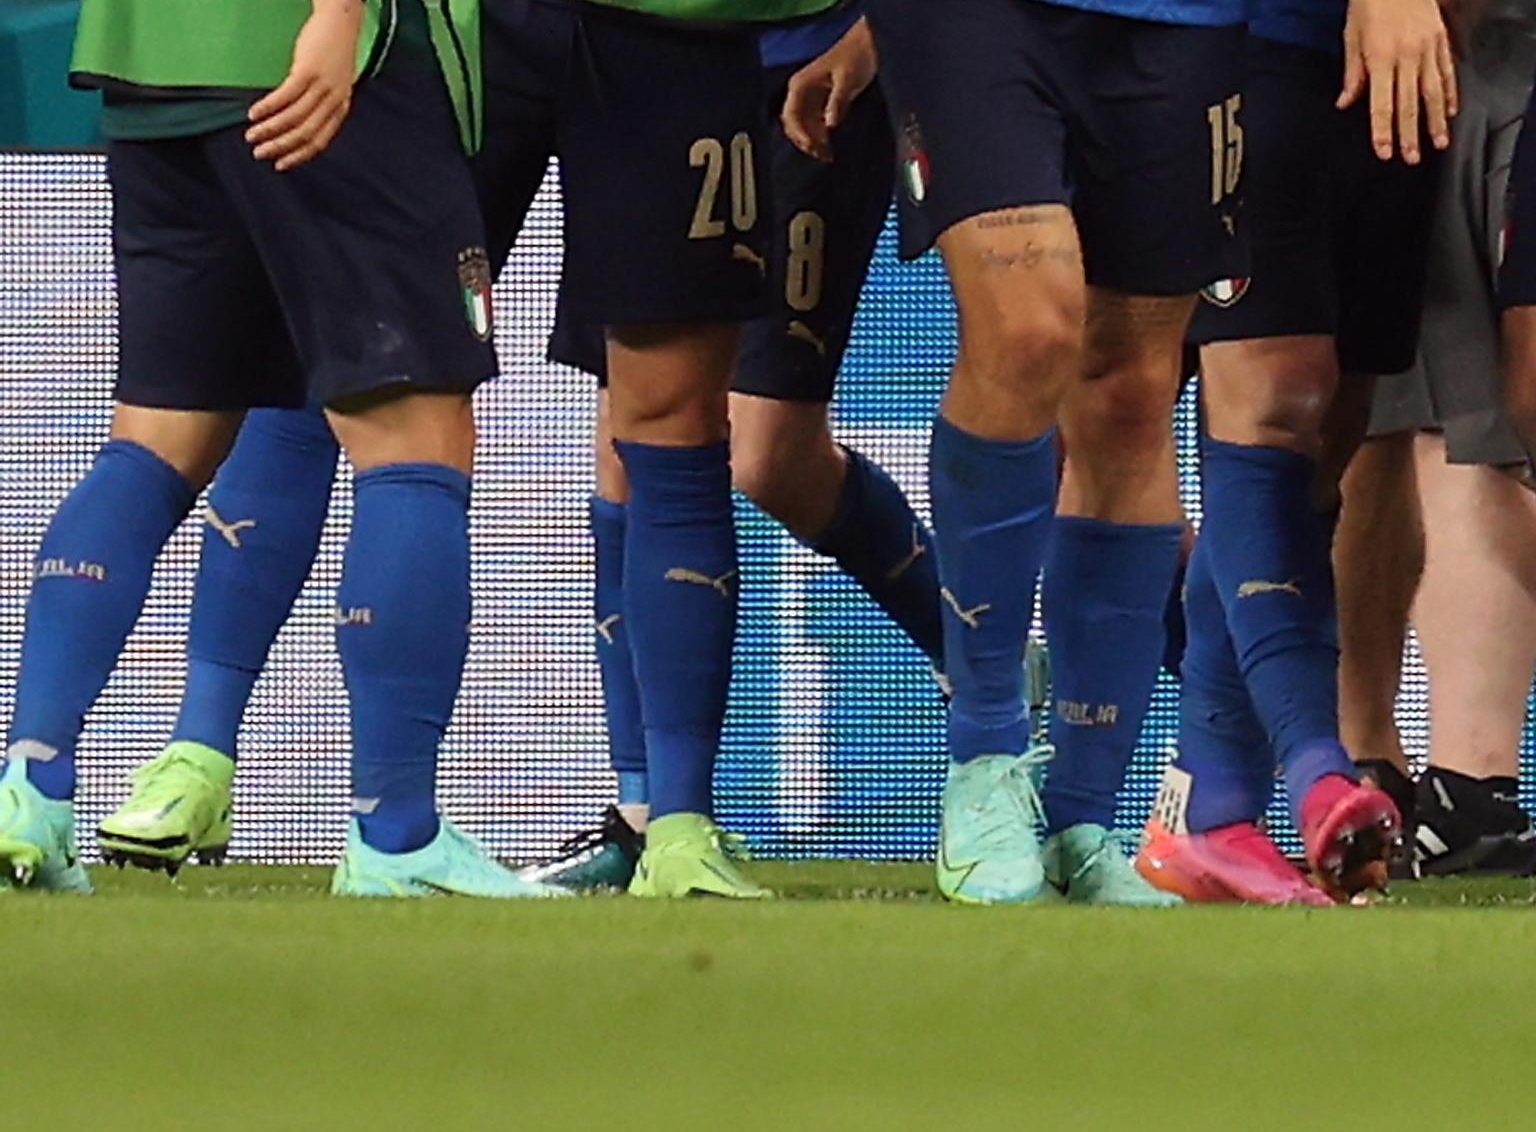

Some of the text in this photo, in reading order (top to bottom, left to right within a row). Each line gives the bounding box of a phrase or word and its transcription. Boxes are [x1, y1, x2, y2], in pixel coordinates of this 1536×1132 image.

[687, 131, 757, 240] 20
[1207, 93, 1244, 206] 15
[785, 210, 825, 313] 8
